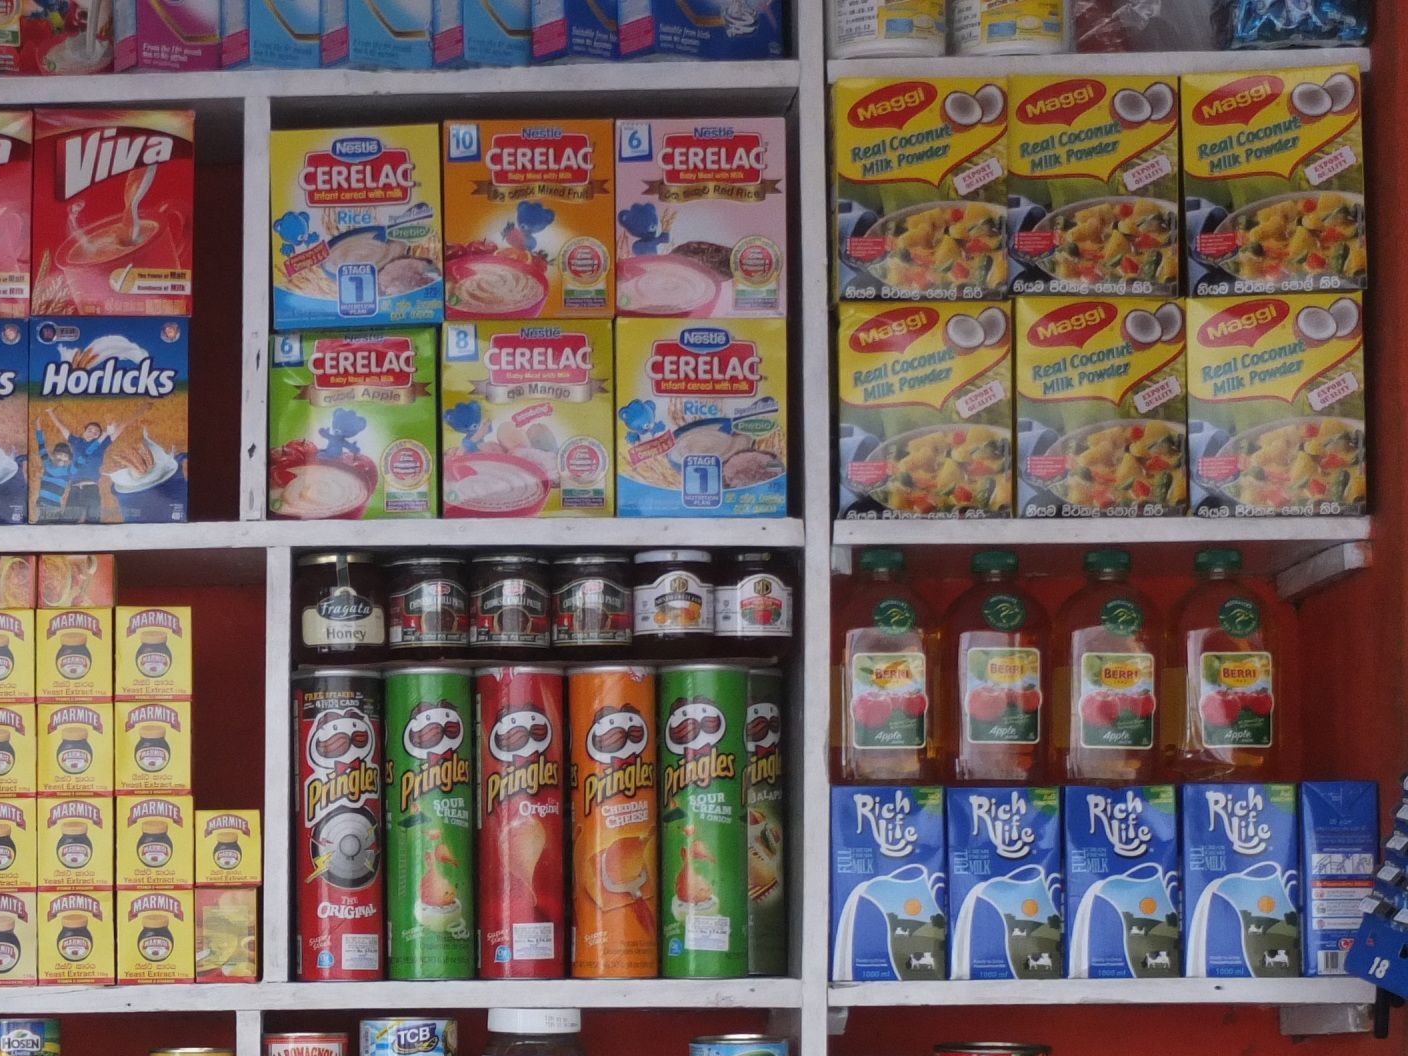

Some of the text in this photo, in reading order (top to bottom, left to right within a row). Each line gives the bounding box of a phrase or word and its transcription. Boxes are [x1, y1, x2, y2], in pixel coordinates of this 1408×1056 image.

[857, 88, 925, 120] Maggi
[1201, 81, 1272, 116] Maggi
[452, 128, 472, 149] 10
[852, 123, 952, 162] Real Coconut
[65, 129, 173, 202] Viva
[486, 147, 593, 171] CERELAC
[657, 147, 766, 170] CERELAC
[861, 143, 950, 176] Milk Powder
[298, 163, 416, 191] CERELAC
[336, 209, 373, 226] Rice
[342, 266, 371, 275] STAGE
[349, 275, 365, 302] 1
[1035, 306, 1107, 339] Maggi
[1207, 305, 1278, 337] Maggi
[455, 331, 470, 349] 8
[308, 346, 416, 375] CERELAC
[484, 345, 592, 370] CERELAC
[645, 354, 762, 380] CERELAC
[42, 358, 176, 398] Horlicks
[528, 380, 571, 399] Mango
[318, 601, 371, 618] Fragata
[49, 615, 100, 634] MARMITE
[326, 626, 367, 641] Honey
[874, 666, 911, 681] BERRI
[1223, 666, 1257, 680] BERRI
[307, 764, 378, 814] Pringles
[400, 761, 470, 812] Pringles
[487, 761, 559, 813] Pringles
[584, 764, 654, 815] Pringles
[664, 751, 735, 806] Pringles
[205, 817, 249, 830] MARMITE
[854, 790, 911, 835] Rich
[1206, 790, 1263, 835] Rich
[877, 818, 918, 858] Life
[1230, 817, 1271, 855] Life
[1370, 957, 1390, 978] 18
